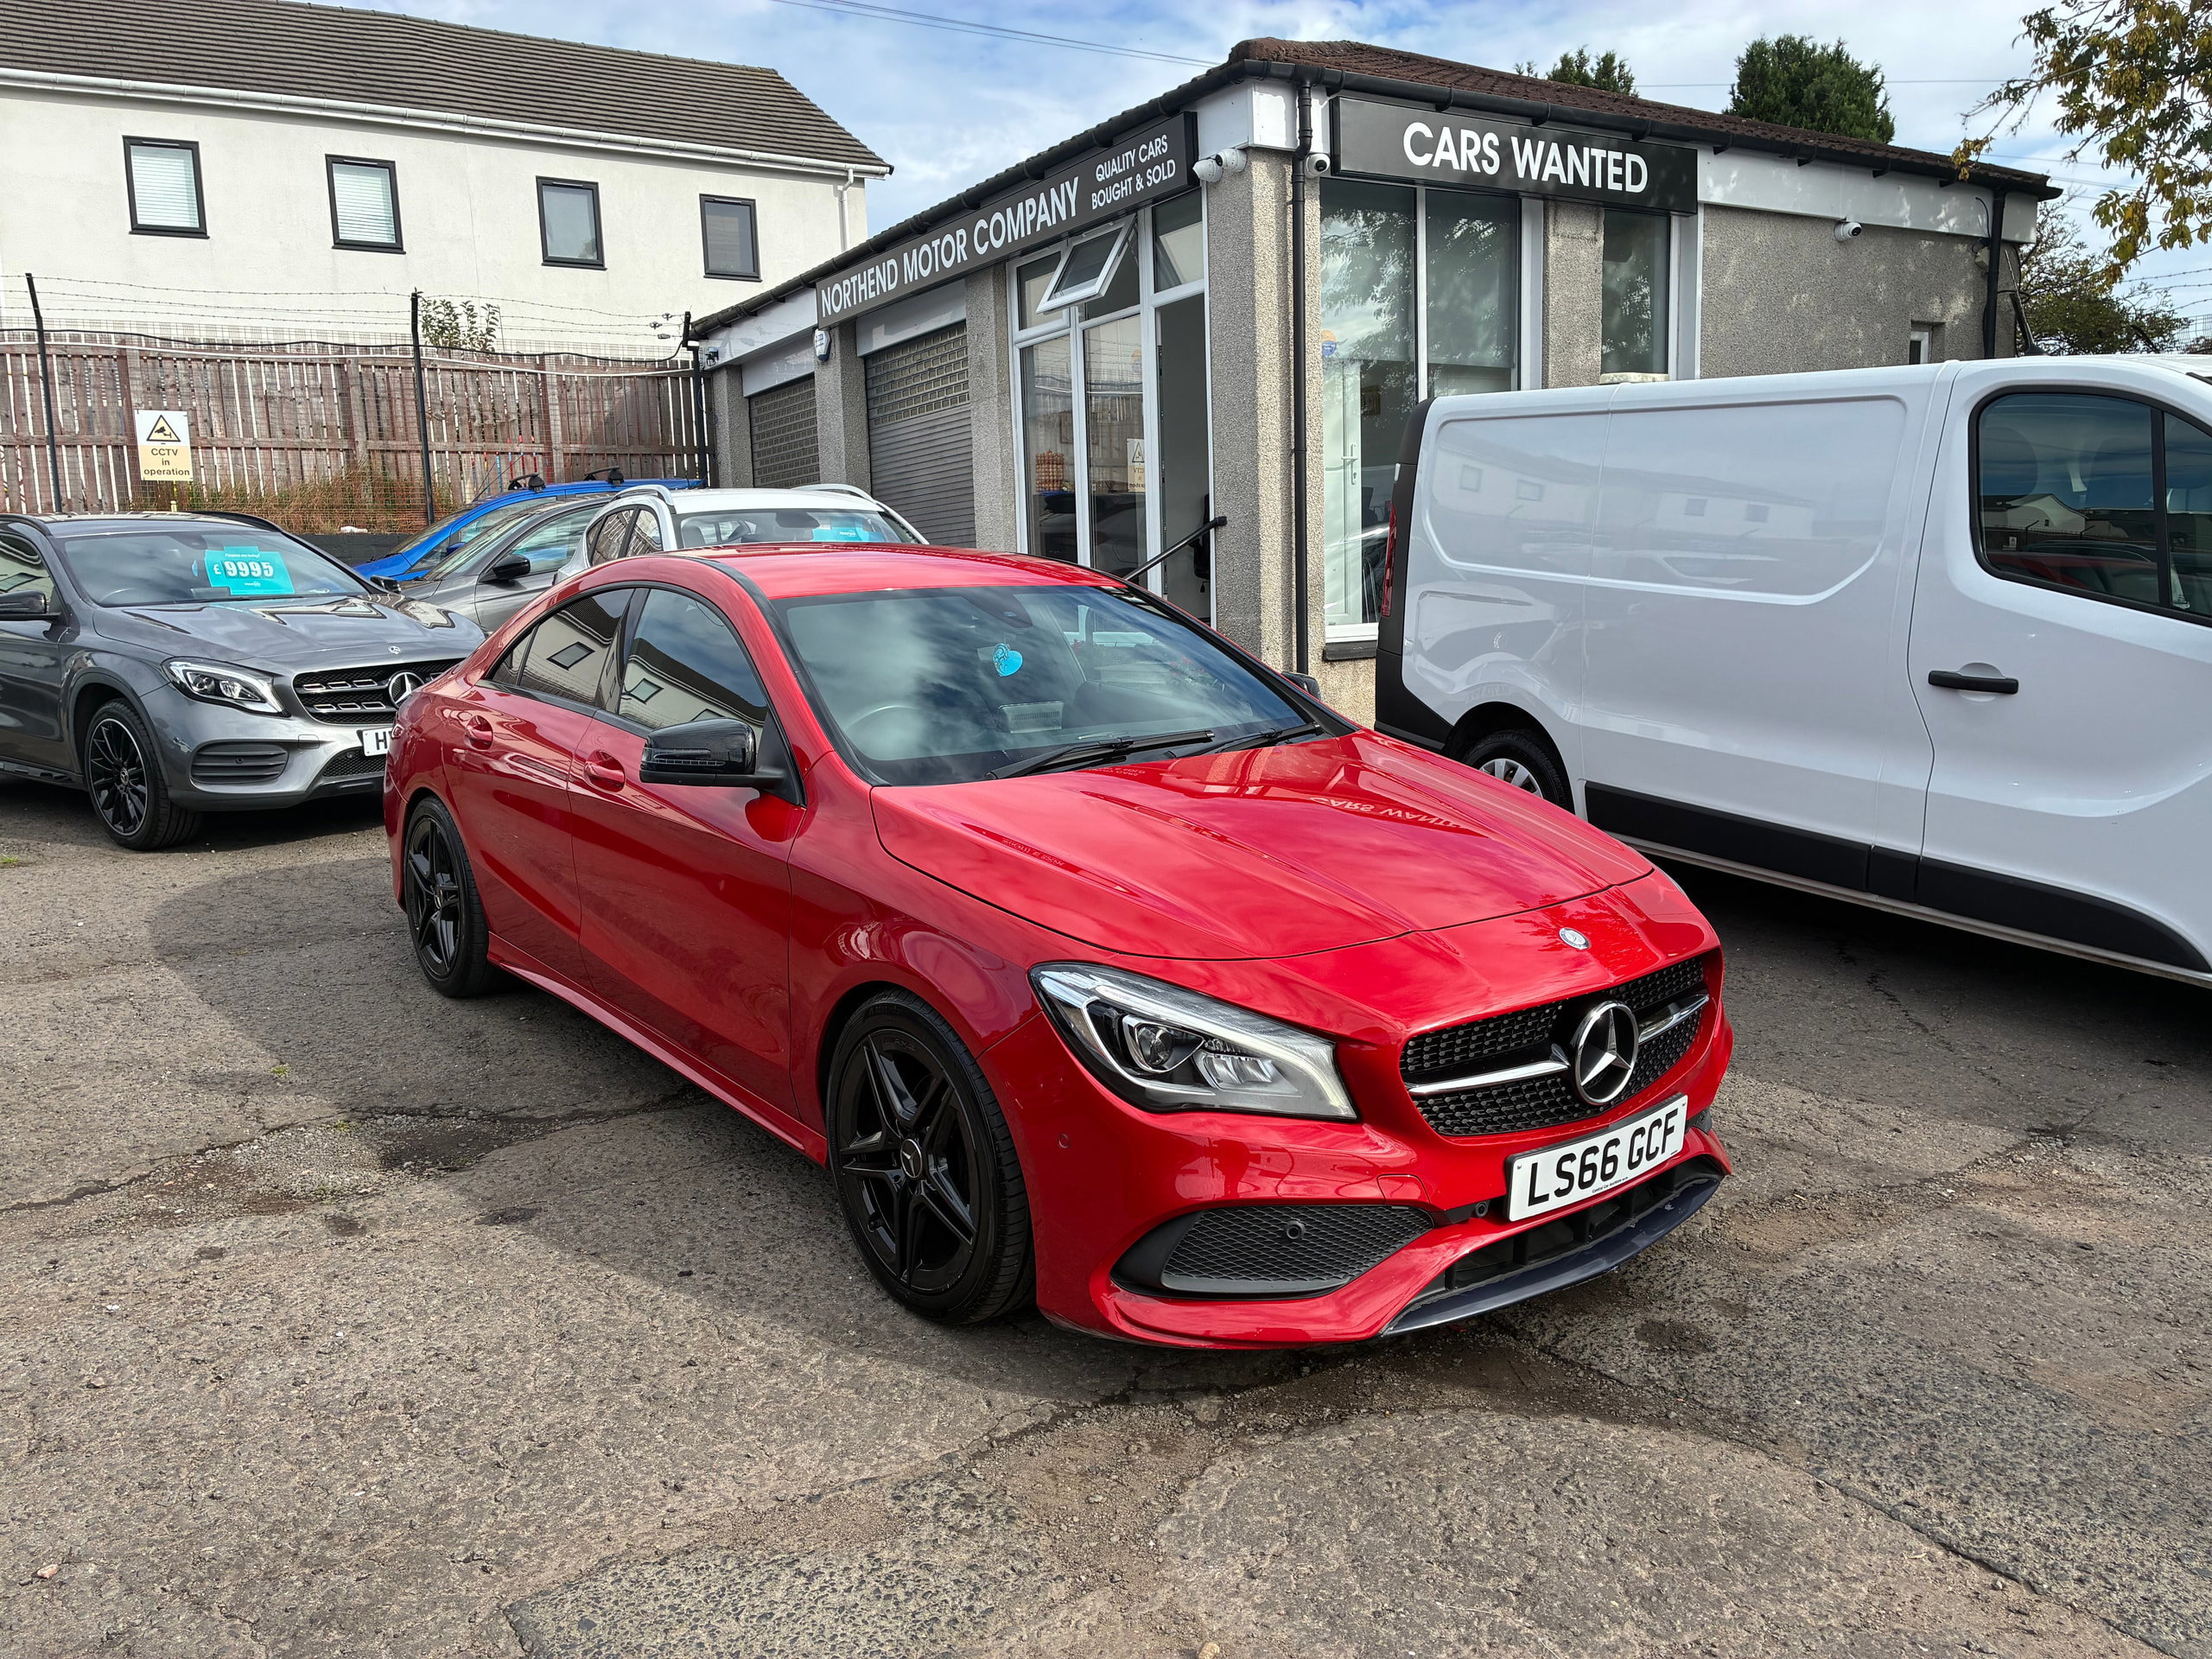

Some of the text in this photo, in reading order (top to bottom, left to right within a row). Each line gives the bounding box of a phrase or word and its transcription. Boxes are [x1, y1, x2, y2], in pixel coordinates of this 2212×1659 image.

[1091, 159, 1176, 210] BOUGHT & SOLD
[1096, 134, 1168, 181] QUALITY CARS
[1403, 122, 1648, 193] CARS WANTED
[822, 176, 1078, 318] NORTHEND MOTOR COMPANY
[150, 448, 178, 456] CCTV
[1528, 1108, 1679, 1207] LS66 GCF
